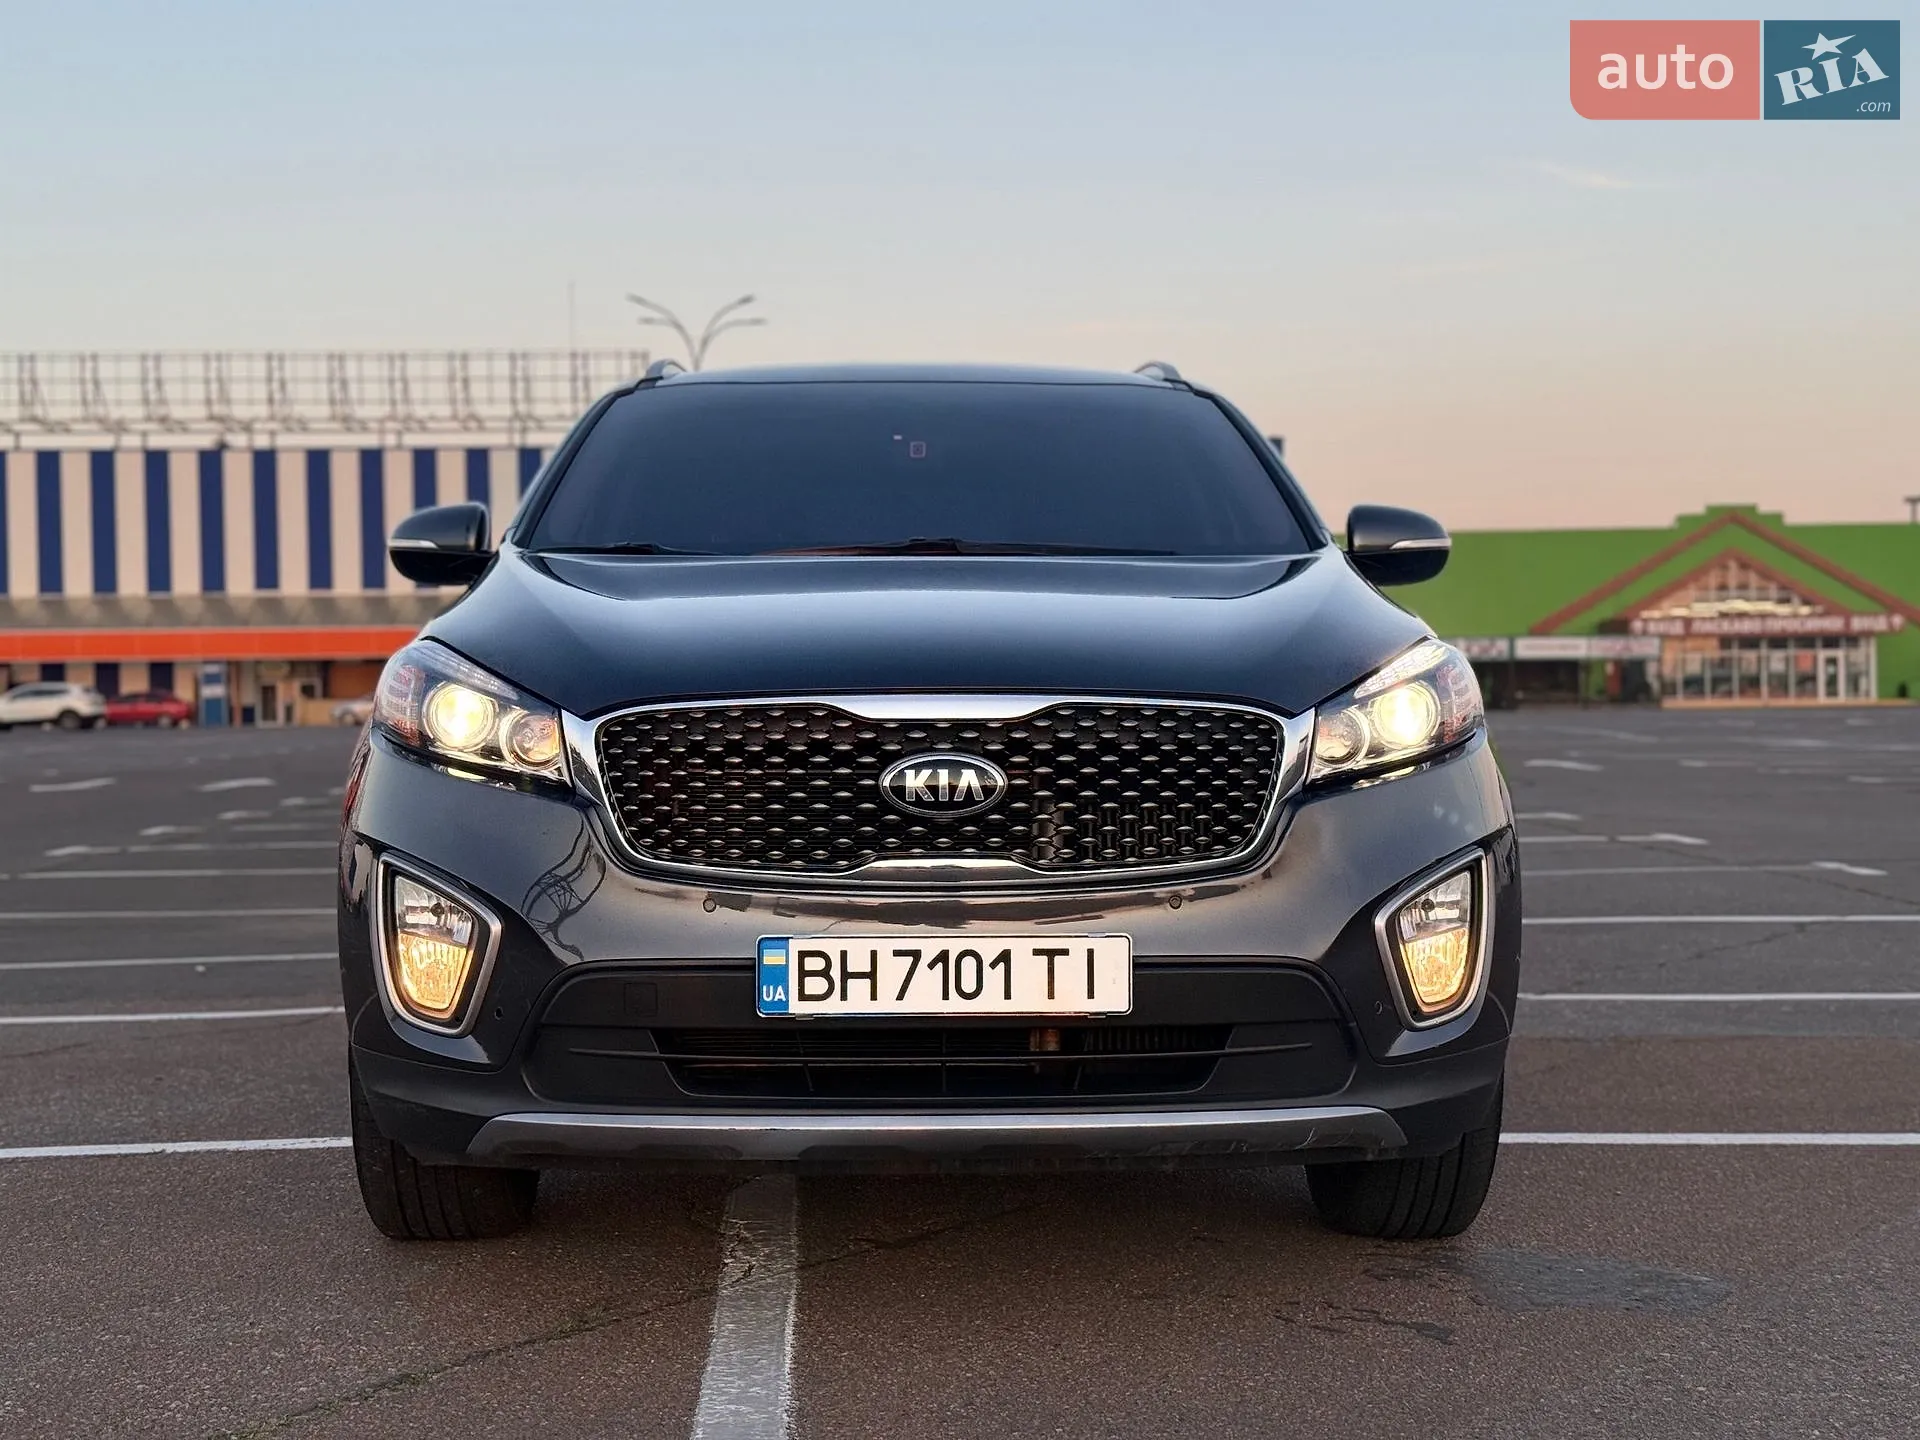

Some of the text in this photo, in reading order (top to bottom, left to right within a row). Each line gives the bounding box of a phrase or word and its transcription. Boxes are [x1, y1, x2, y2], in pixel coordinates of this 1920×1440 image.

[903, 768, 986, 802] KIA
[797, 949, 878, 1002] BH
[892, 948, 1012, 1001] 7101
[762, 984, 787, 1002] UA
